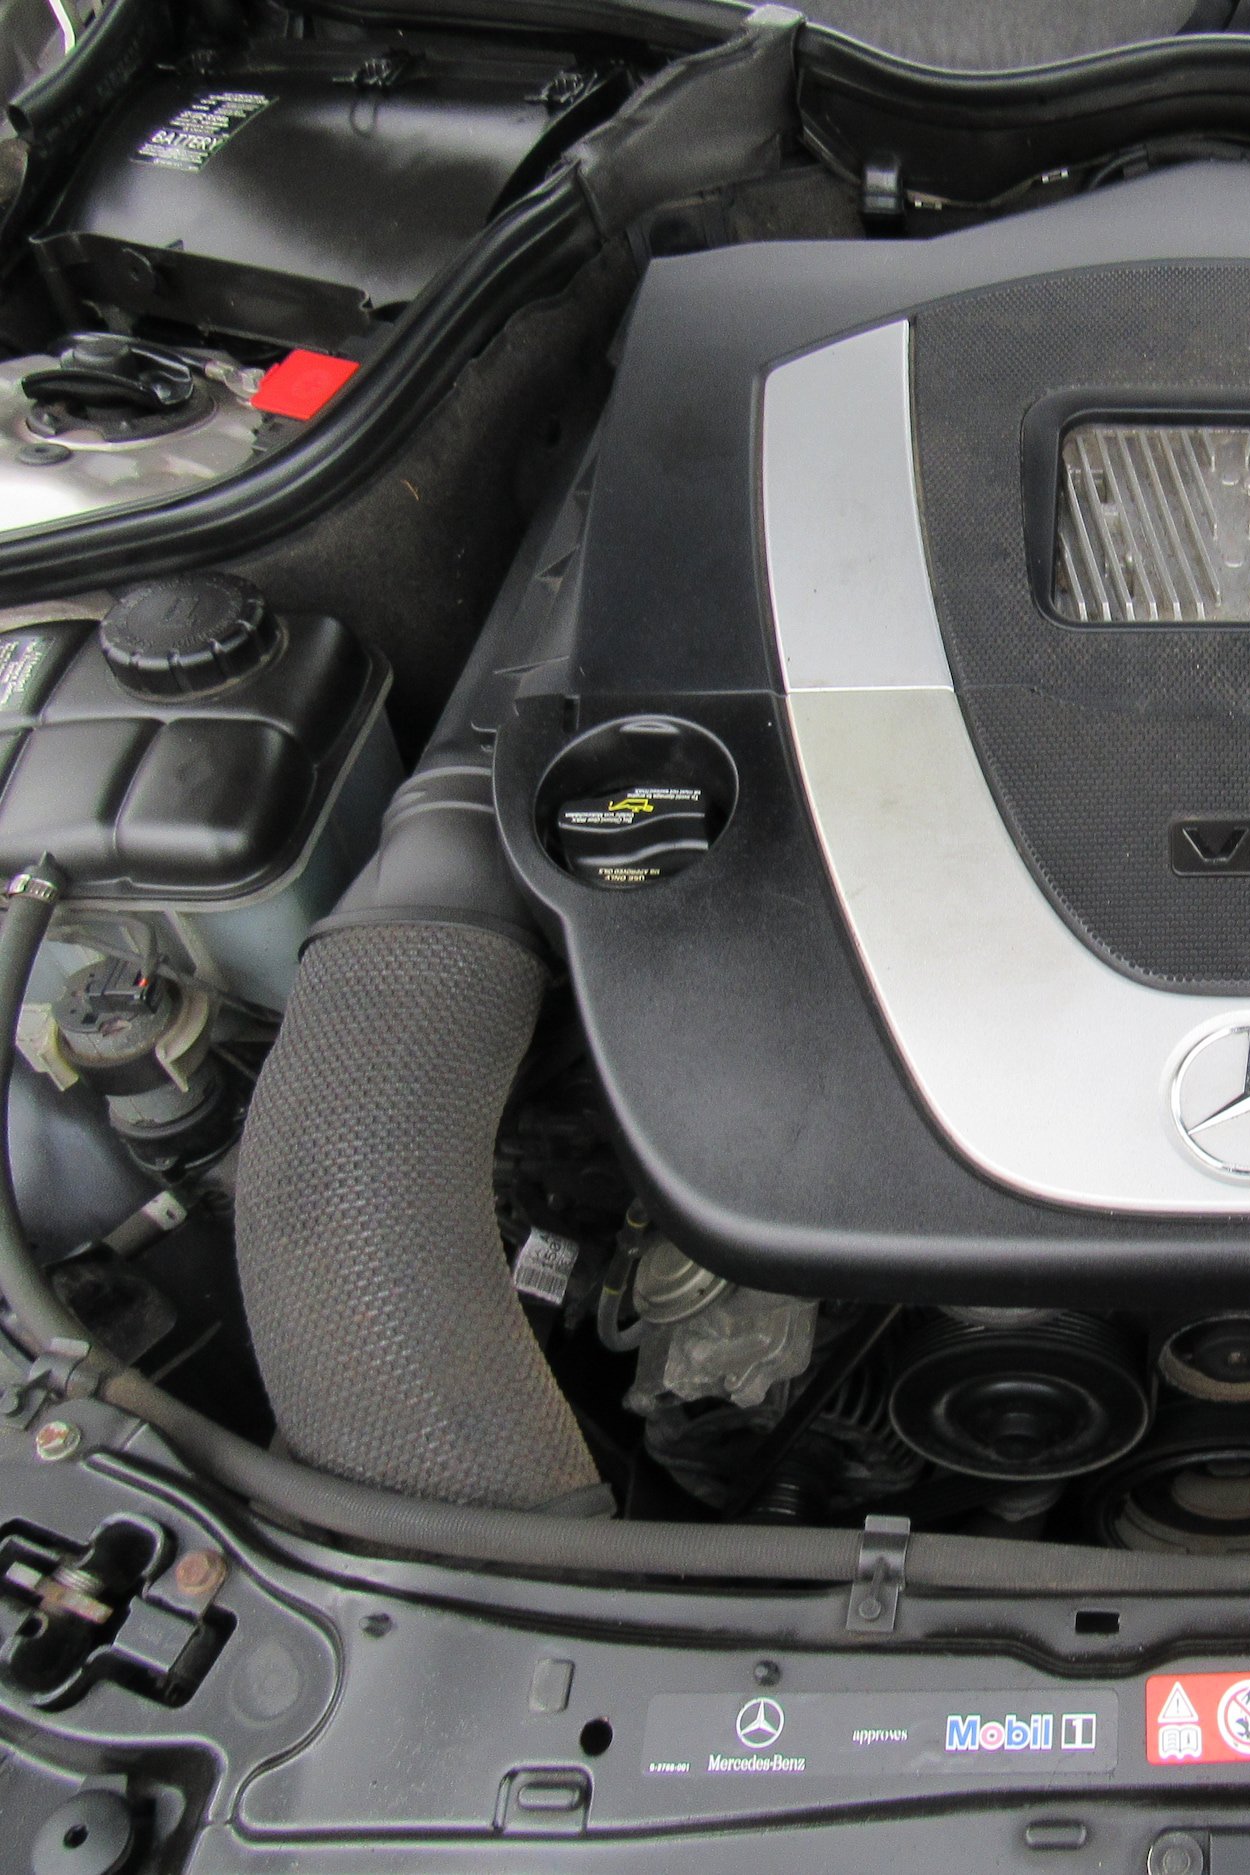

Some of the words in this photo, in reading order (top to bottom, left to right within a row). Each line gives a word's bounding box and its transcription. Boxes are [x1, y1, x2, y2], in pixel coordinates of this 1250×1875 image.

[152, 130, 222, 151] BATTERY
[945, 1713, 1054, 1751] Mobil
[707, 1753, 806, 1772] Mercedes-Benz
